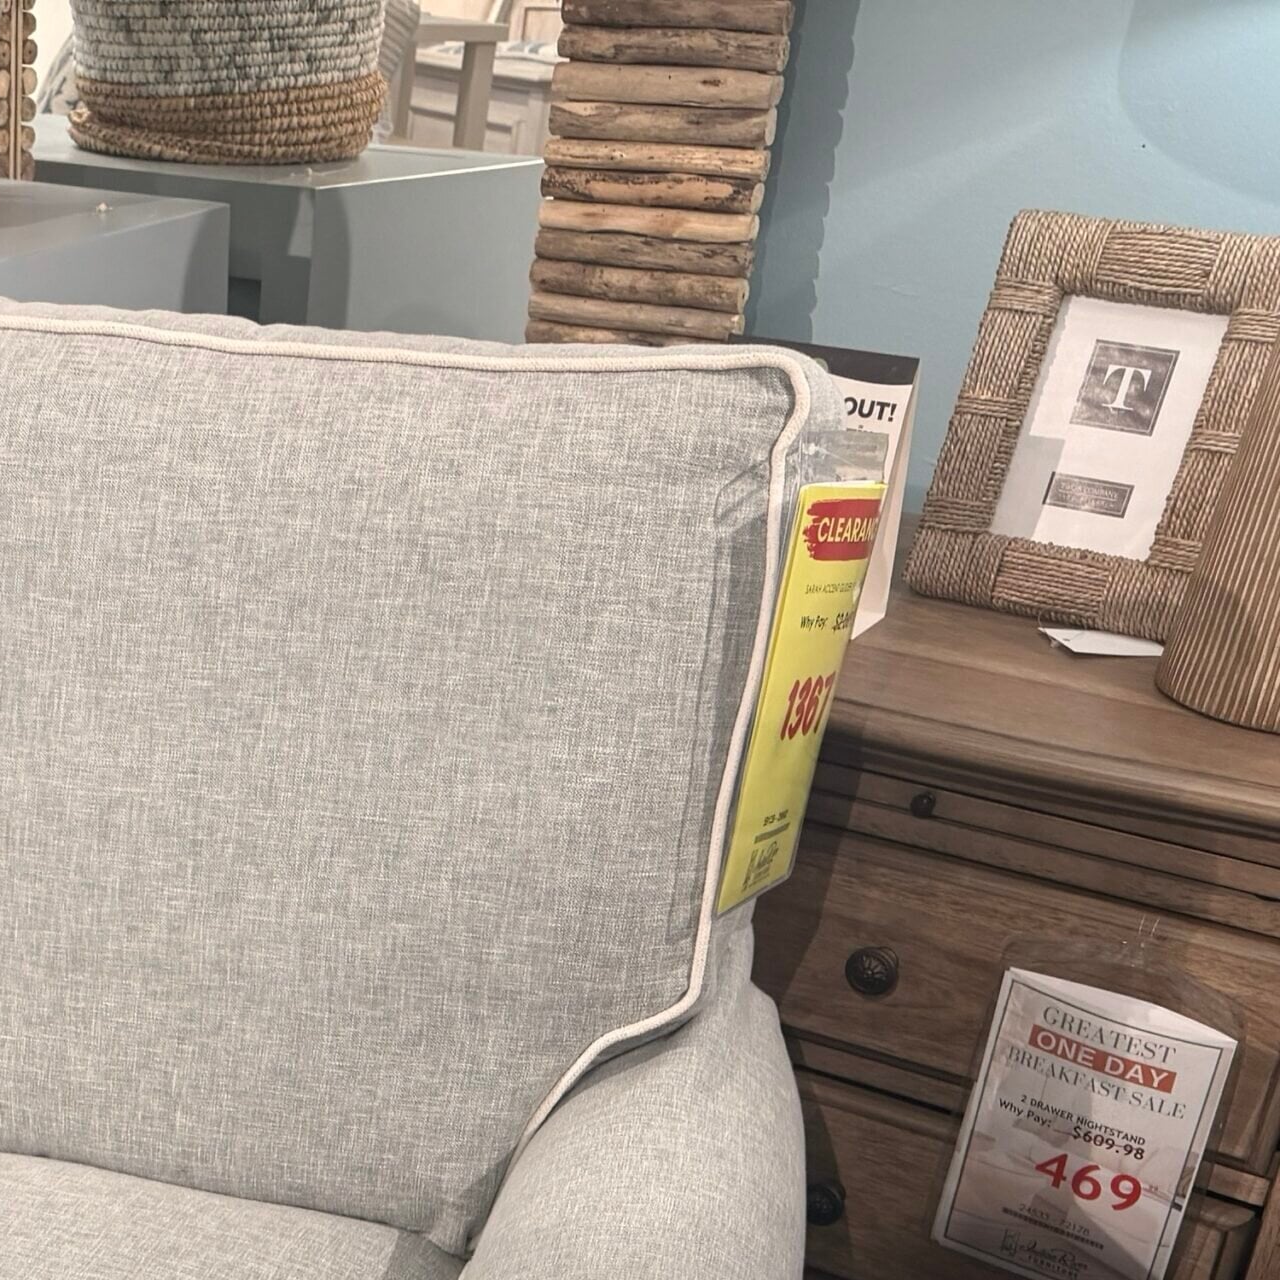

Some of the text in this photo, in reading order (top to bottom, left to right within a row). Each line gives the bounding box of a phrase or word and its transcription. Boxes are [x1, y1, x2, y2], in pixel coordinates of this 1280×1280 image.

[1102, 364, 1153, 412] T
[800, 616, 814, 631] Why
[1036, 1030, 1169, 1089] ONE DAY
[1043, 1006, 1176, 1063] GREATEST
[1007, 1044, 1187, 1120] BREAKFAST SALE
[999, 1098, 1145, 1160] Why Pay: $609.98
[1020, 1094, 1146, 1146] 2 DRAWER NIGHTSTAND
[1035, 1153, 1142, 1211] 469
